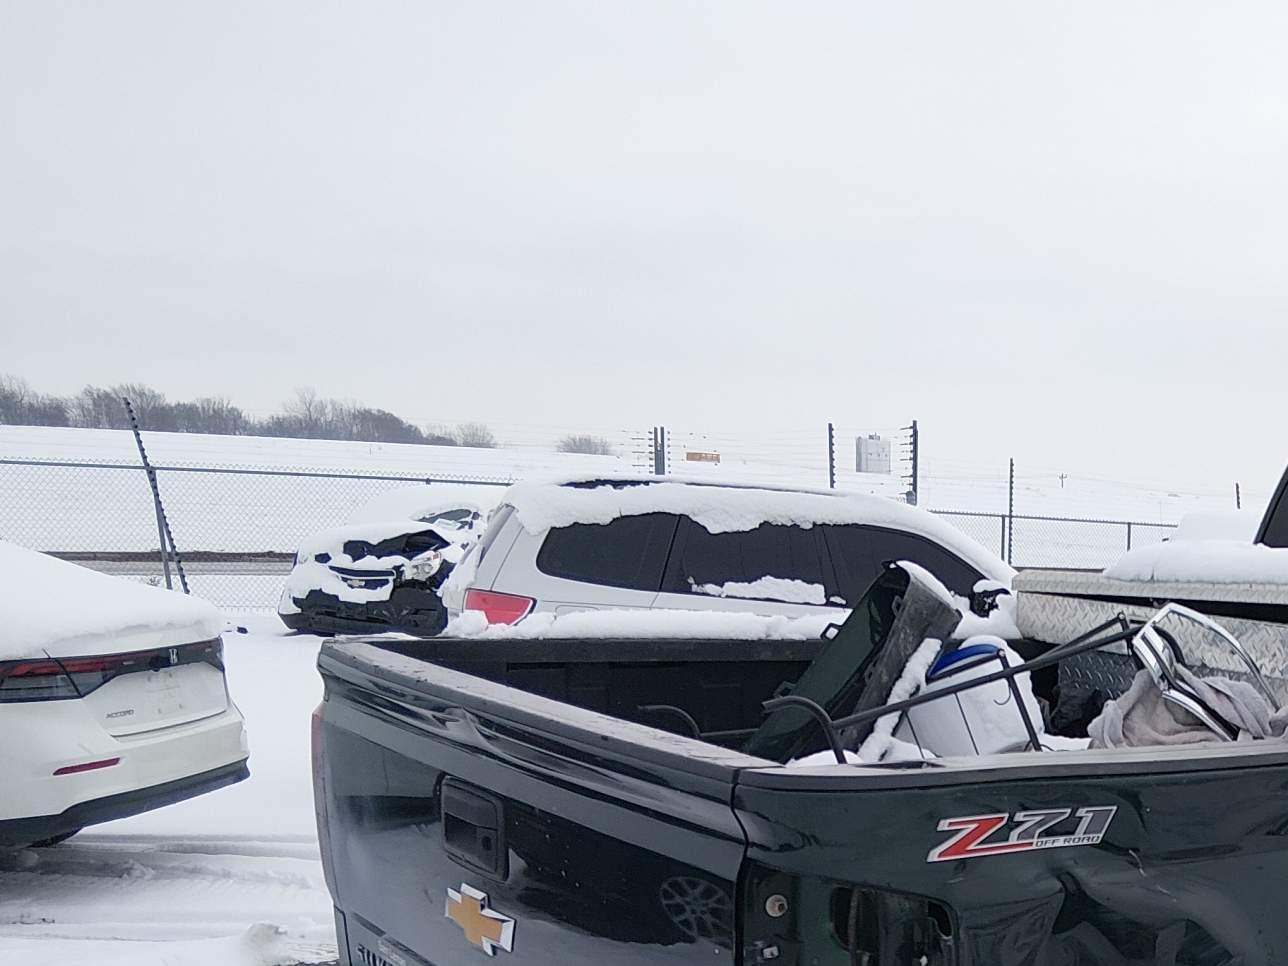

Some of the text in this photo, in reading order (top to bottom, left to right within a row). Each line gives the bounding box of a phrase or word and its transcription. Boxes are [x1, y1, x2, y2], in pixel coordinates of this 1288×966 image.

[106, 709, 134, 719] ACCORD
[927, 806, 1117, 862] Z71
[1035, 834, 1100, 848] OFF ROAD
